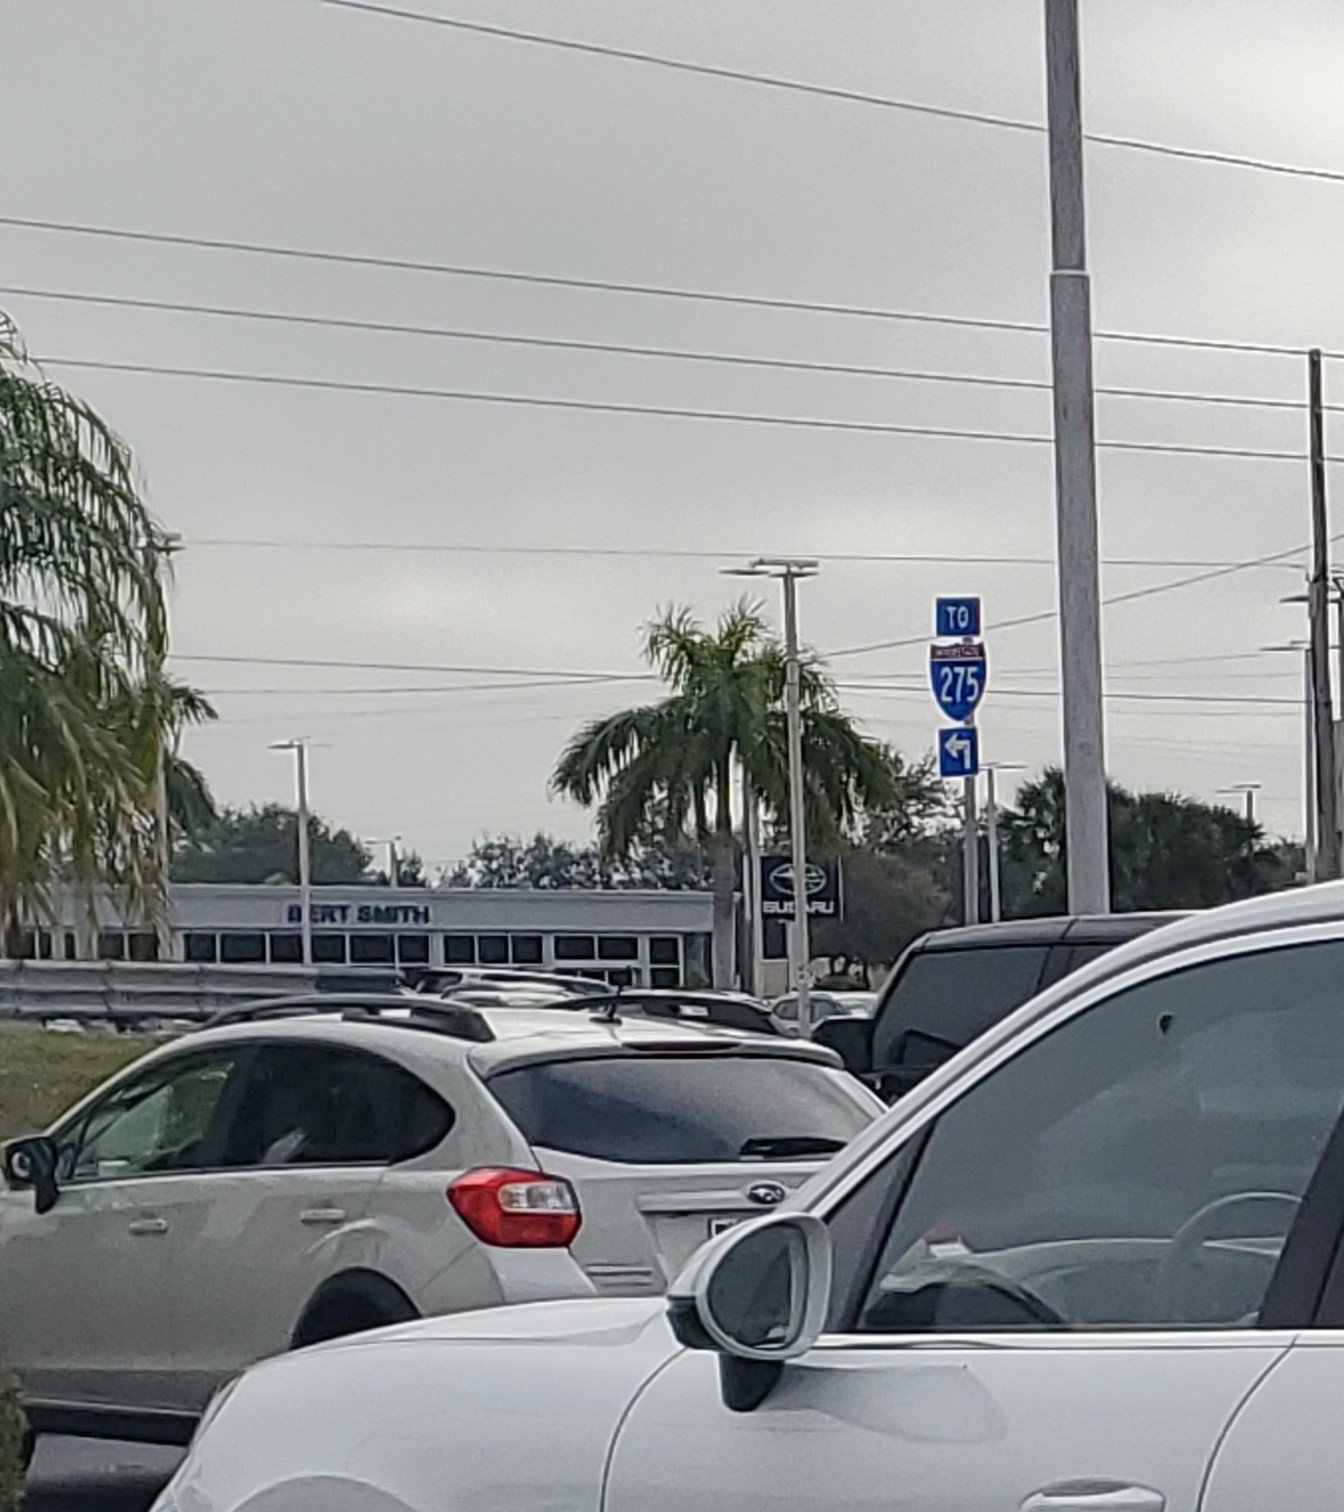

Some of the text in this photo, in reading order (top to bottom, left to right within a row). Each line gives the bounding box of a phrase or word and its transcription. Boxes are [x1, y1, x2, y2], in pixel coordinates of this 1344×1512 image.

[946, 606, 969, 629] TO
[941, 666, 979, 702] 275
[356, 905, 430, 924] SMITH
